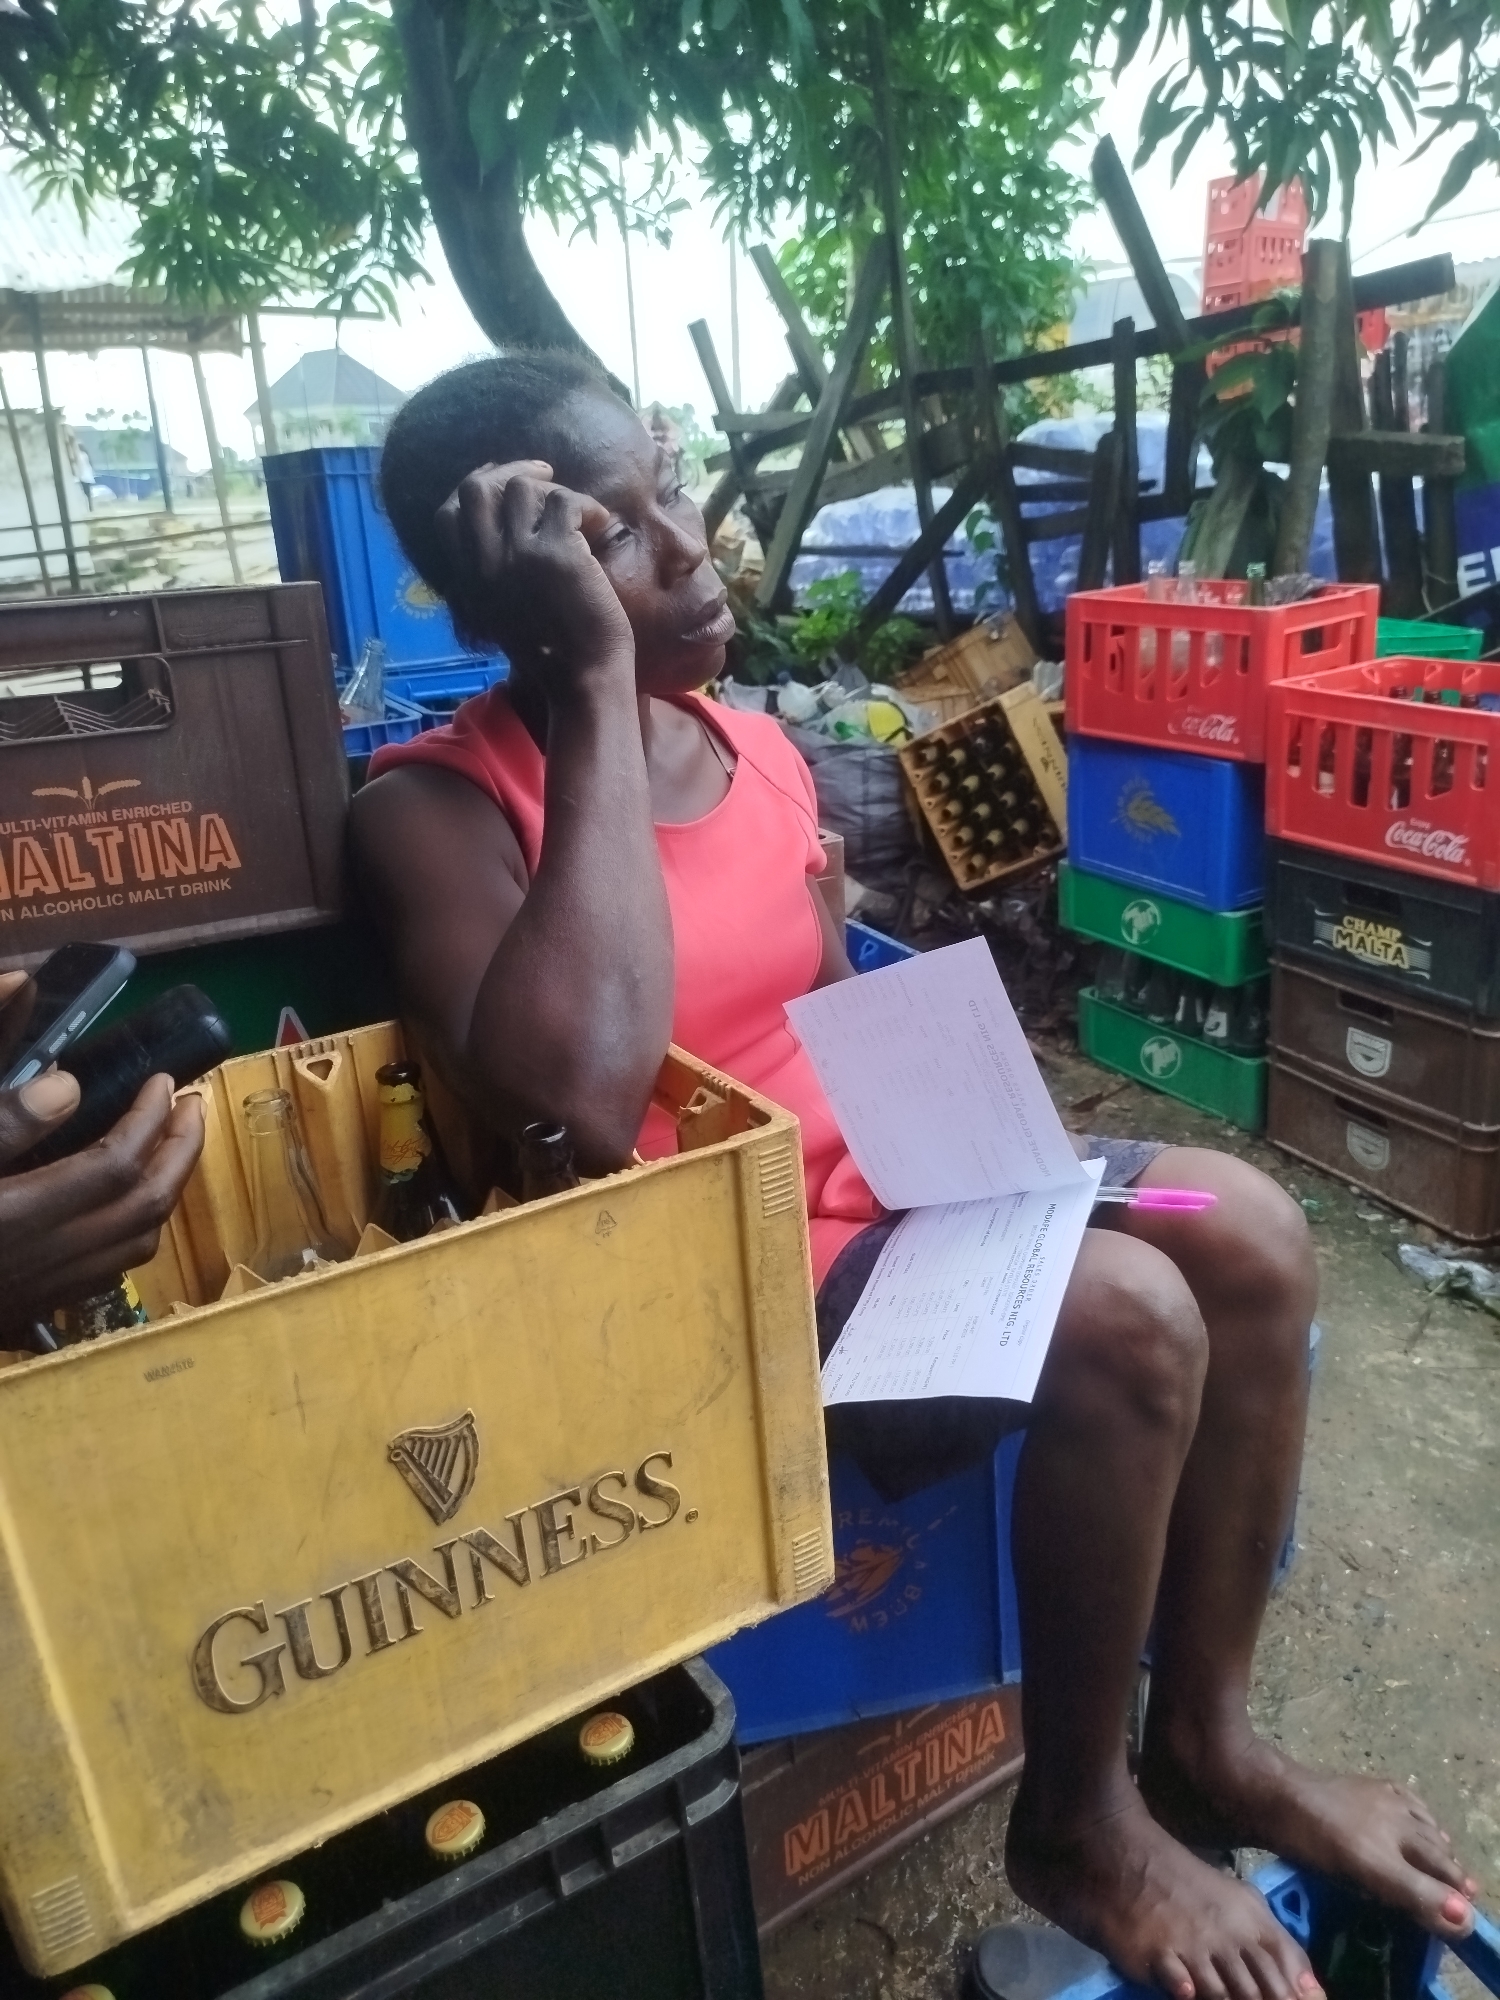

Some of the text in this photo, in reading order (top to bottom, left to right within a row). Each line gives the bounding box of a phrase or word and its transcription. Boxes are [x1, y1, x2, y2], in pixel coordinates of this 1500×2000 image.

[0, 800, 193, 835] ULTI-VITAMIN ENRICHED
[1385, 820, 1469, 863] Coca-Cola
[21, 893, 124, 920] ALCOHOLIC
[129, 886, 173, 904] MALT
[180, 877, 232, 897] DRINK
[1333, 925, 1409, 969] MALTA
[1343, 915, 1402, 943] CHAMP
[1028, 1232, 1045, 1263] GLOBAL
[1012, 1262, 1035, 1310] RESOURCES
[997, 1329, 1011, 1348] LTD
[192, 1450, 682, 1715] GUINNESS
[784, 1699, 1008, 1876] MALTINA
[797, 1750, 995, 1886] NON ALCOHOLIC MALT DRINK
